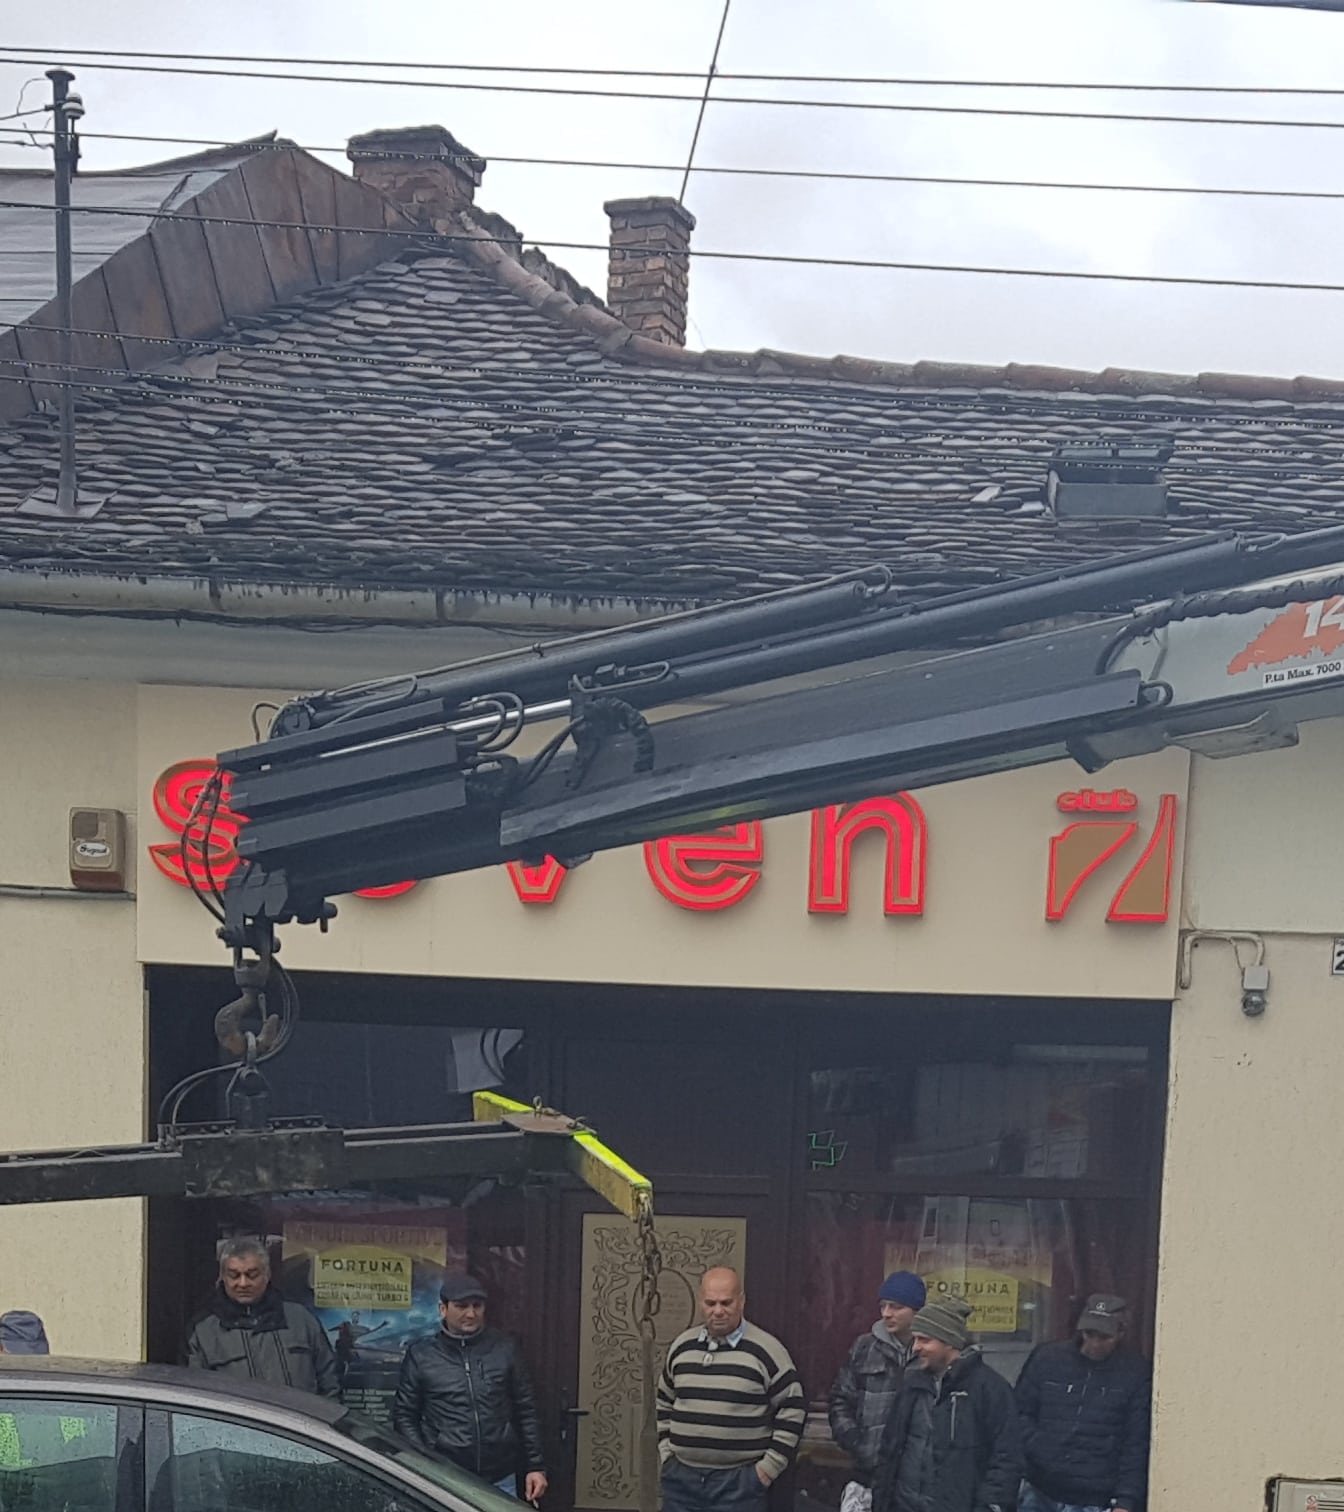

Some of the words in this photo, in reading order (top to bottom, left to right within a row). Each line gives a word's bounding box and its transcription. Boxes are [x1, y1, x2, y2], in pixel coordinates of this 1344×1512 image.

[1287, 667, 1314, 681] Max.
[1317, 661, 1342, 675] 7000
[1056, 788, 1139, 813] club
[321, 1258, 404, 1273] FORTUNA
[927, 1280, 1010, 1294] FORTUNA
